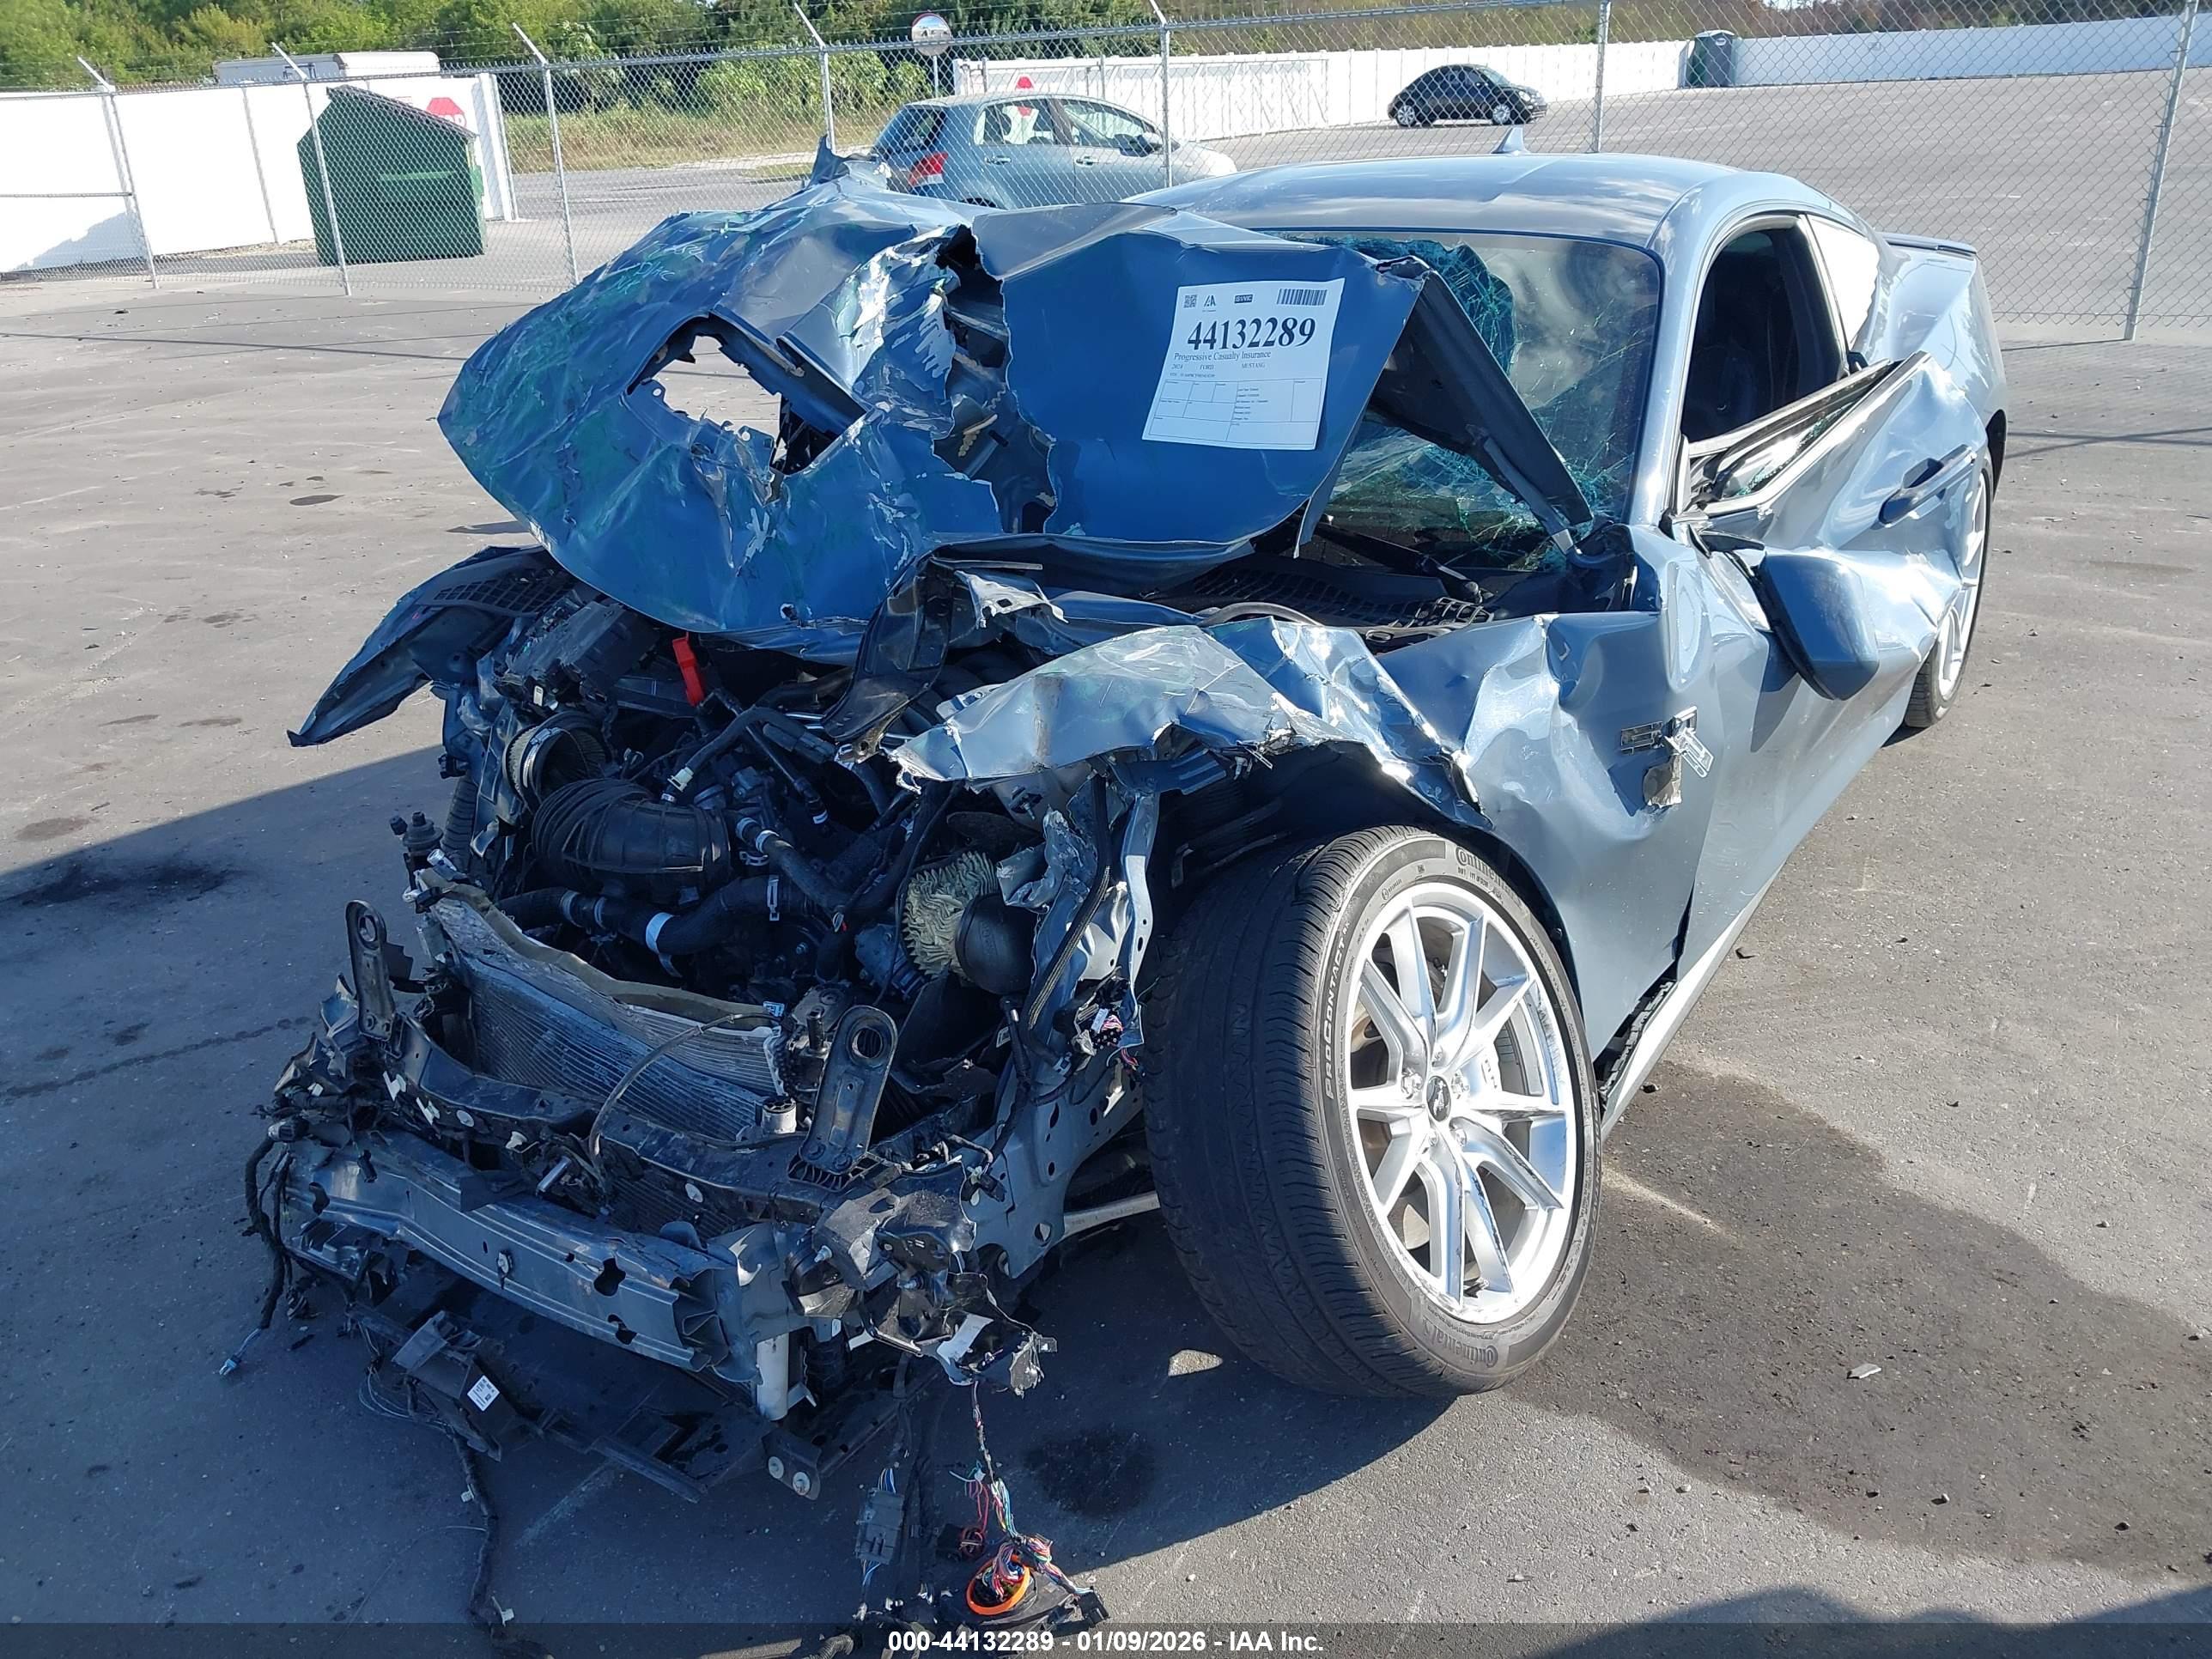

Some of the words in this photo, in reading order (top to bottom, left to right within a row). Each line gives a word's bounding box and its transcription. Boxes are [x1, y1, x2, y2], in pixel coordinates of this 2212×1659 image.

[1188, 317, 1316, 350] 44132289
[1174, 352, 1212, 363] Progressive
[1213, 351, 1240, 362] Casualty
[1242, 350, 1271, 359] Insurance
